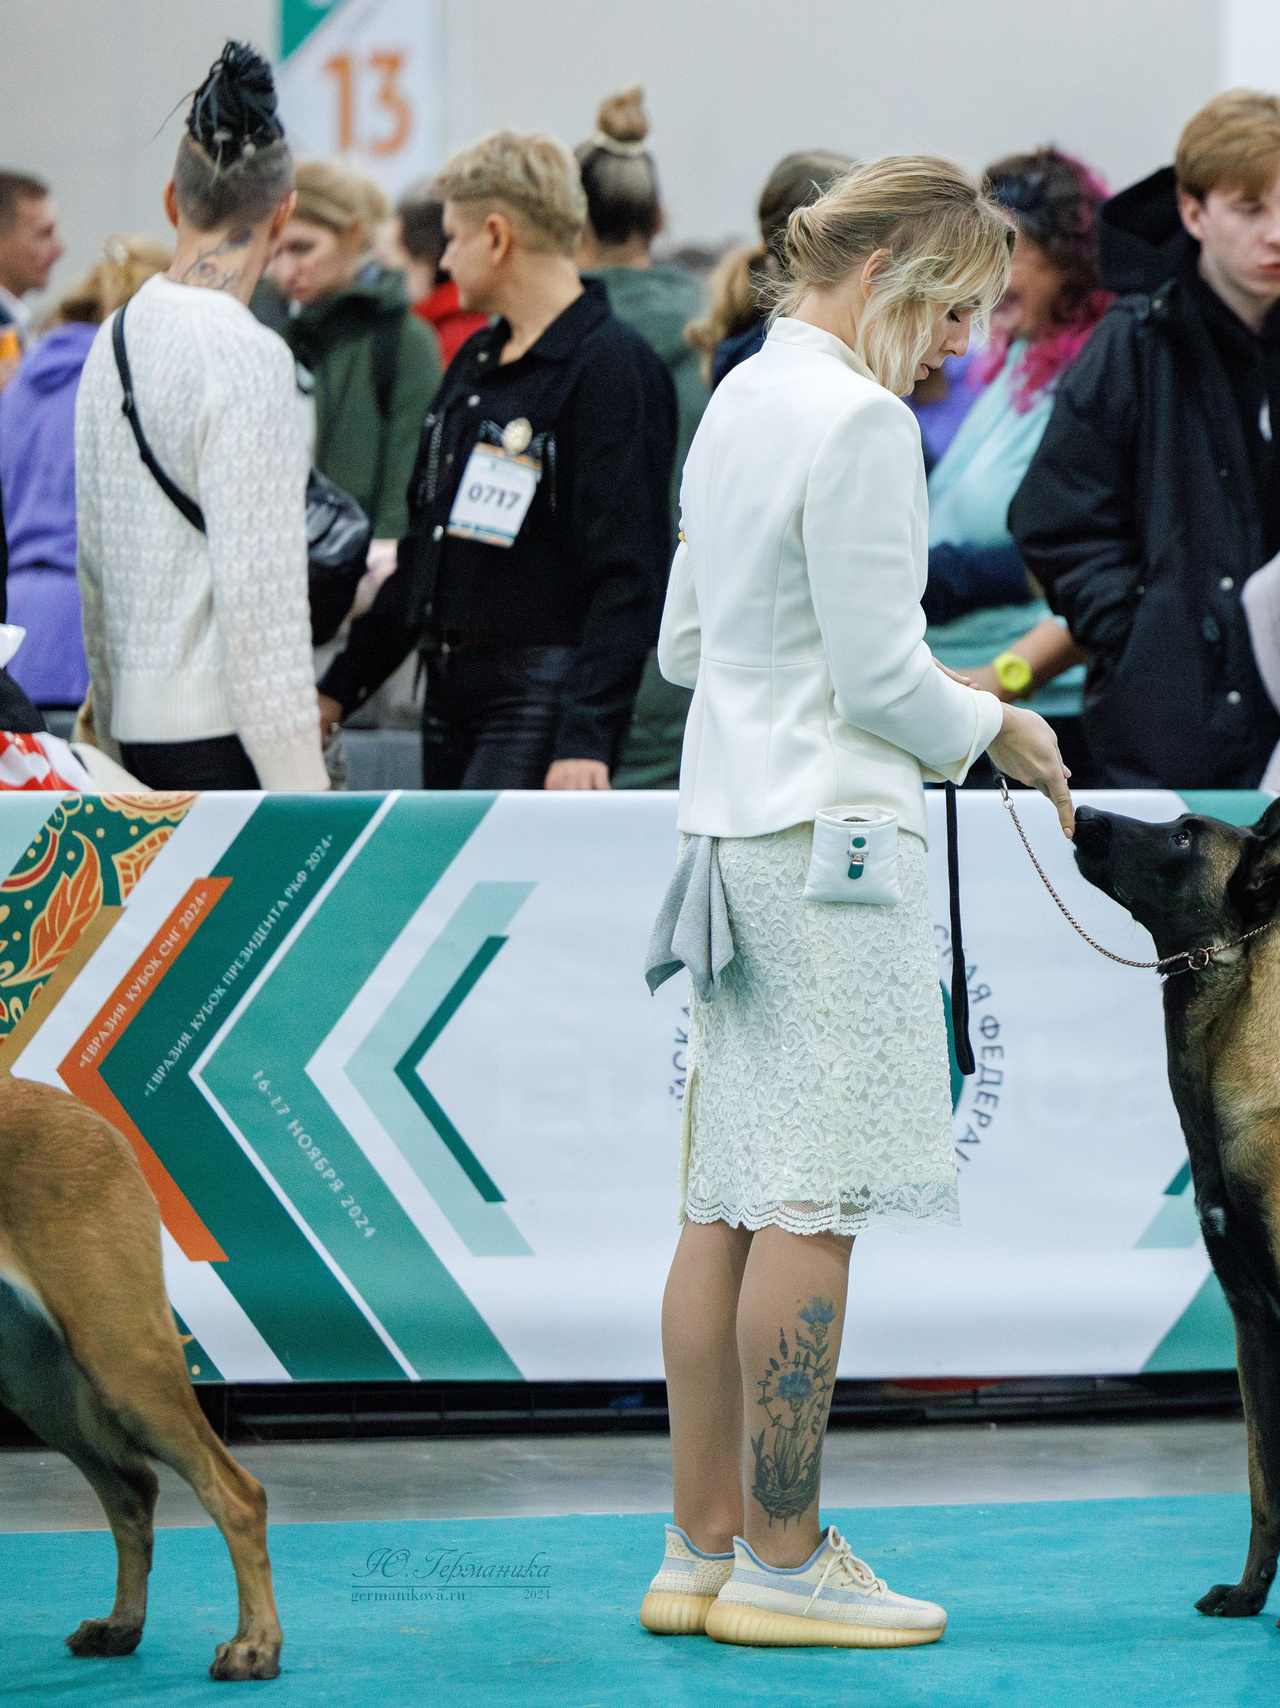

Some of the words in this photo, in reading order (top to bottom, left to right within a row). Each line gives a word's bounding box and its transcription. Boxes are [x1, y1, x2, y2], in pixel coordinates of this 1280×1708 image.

[324, 52, 411, 156] 13
[468, 483, 521, 511] 0717
[125, 956, 162, 1002] КУБОК
[159, 926, 181, 957] СНГ
[190, 984, 227, 1031] КУБОК
[222, 900, 289, 986] ПРЕЗИДЕНТА
[284, 870, 307, 899] РКФ
[252, 1070, 290, 1115] 16-17
[287, 1119, 344, 1193] НОЯБРЯ
[341, 1195, 376, 1238] 2024
[955, 1015, 1004, 1173] ФЕДЕРА
